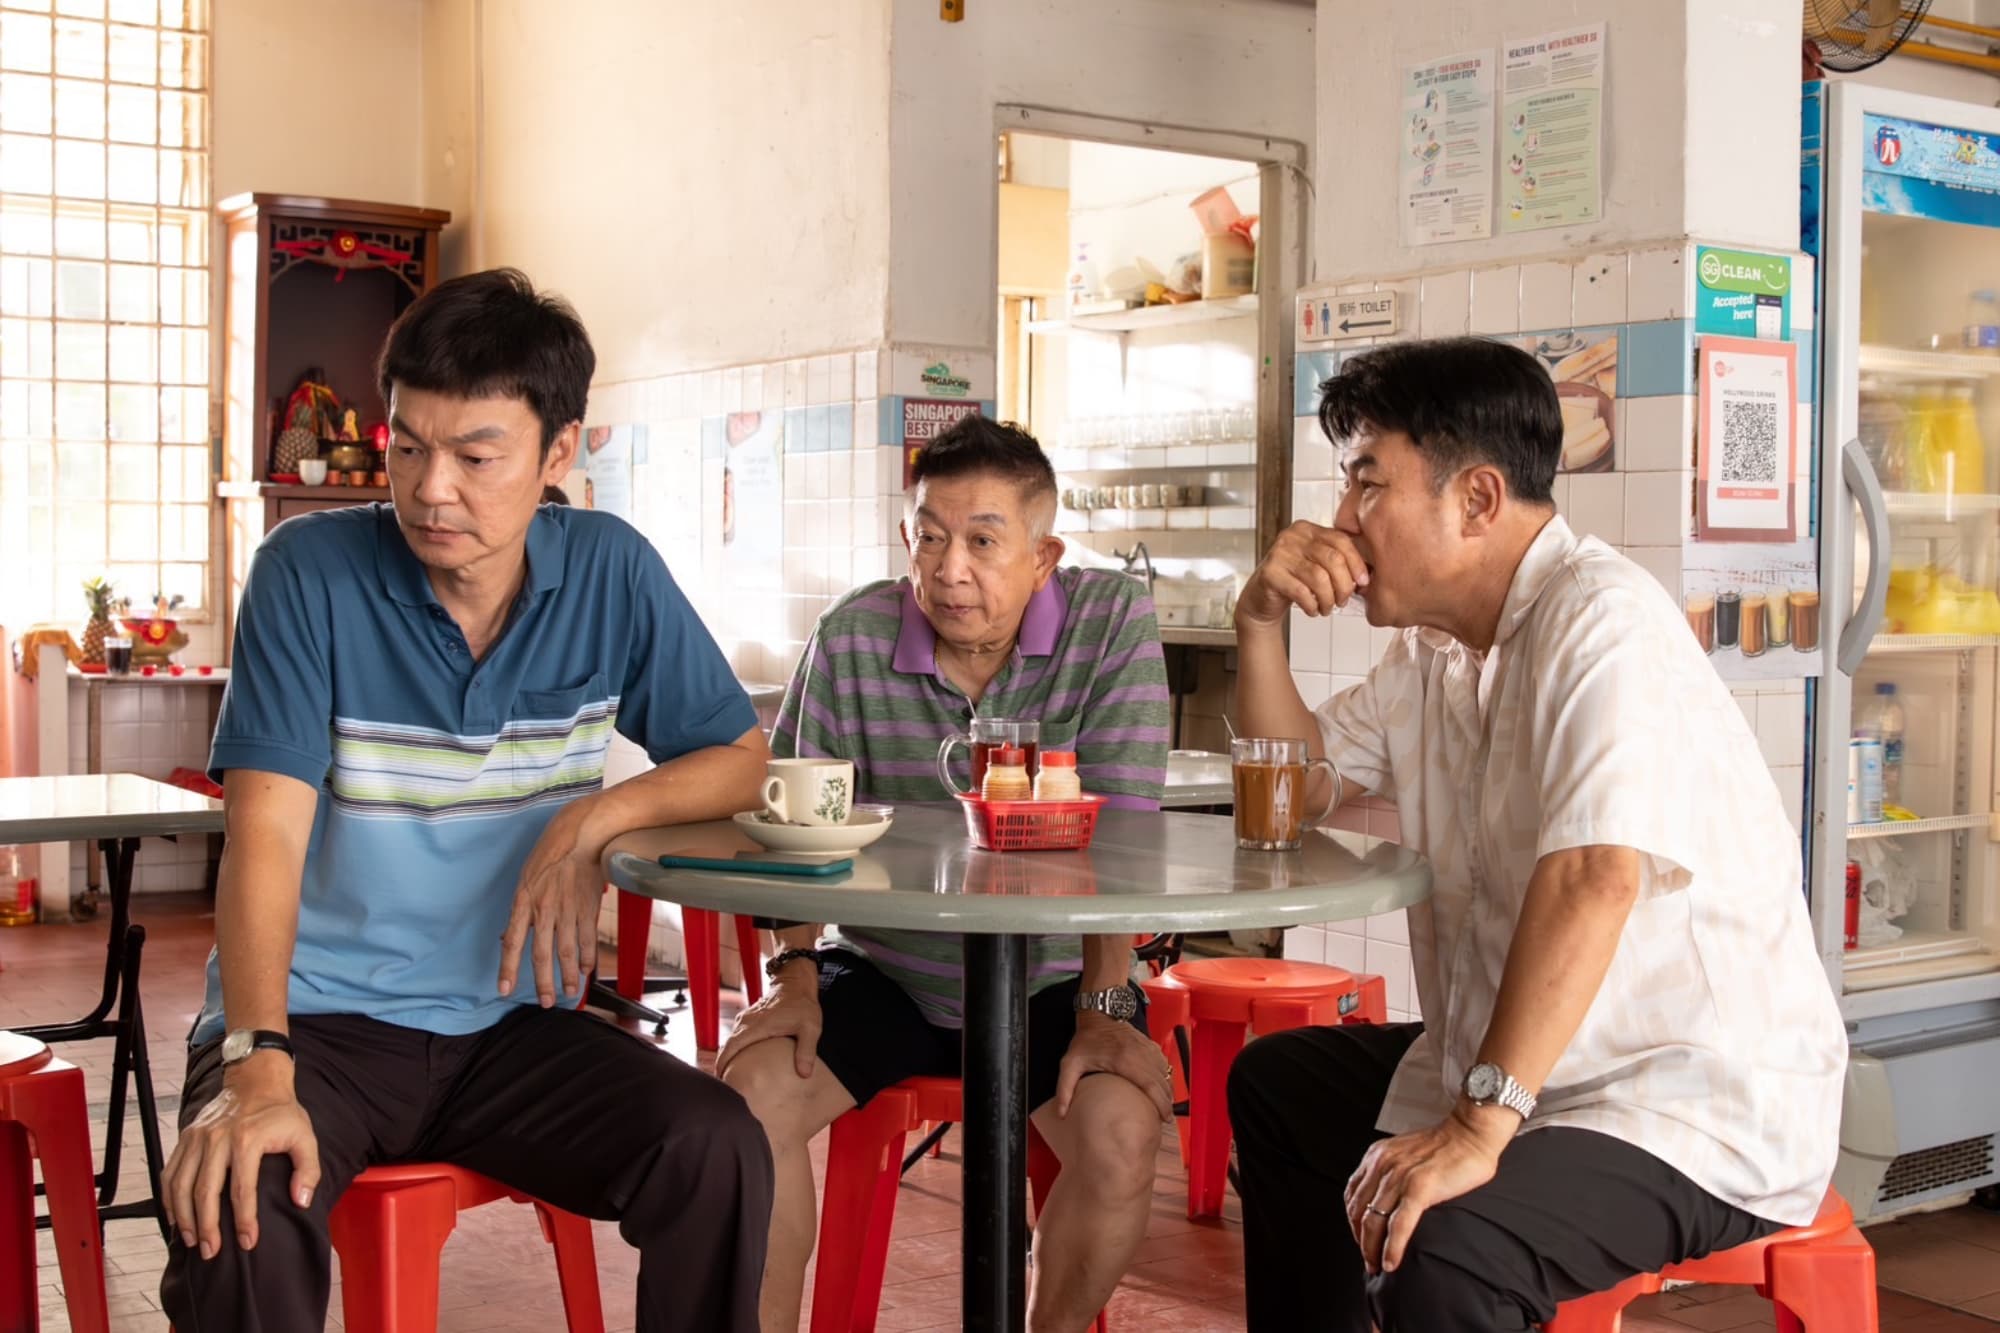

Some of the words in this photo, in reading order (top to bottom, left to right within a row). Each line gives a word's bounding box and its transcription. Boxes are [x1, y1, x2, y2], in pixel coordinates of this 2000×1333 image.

[1509, 45, 1535, 58] HEALTHIER
[1561, 34, 1588, 47] HEALTHIER
[1703, 262, 1719, 276] SG
[1722, 264, 1761, 280] CLEAN
[1360, 300, 1392, 313] TOILET
[1713, 294, 1753, 308] Accepted
[1734, 308, 1753, 320] here
[921, 374, 971, 390] SINGAPORE
[907, 422, 936, 436] BEST
